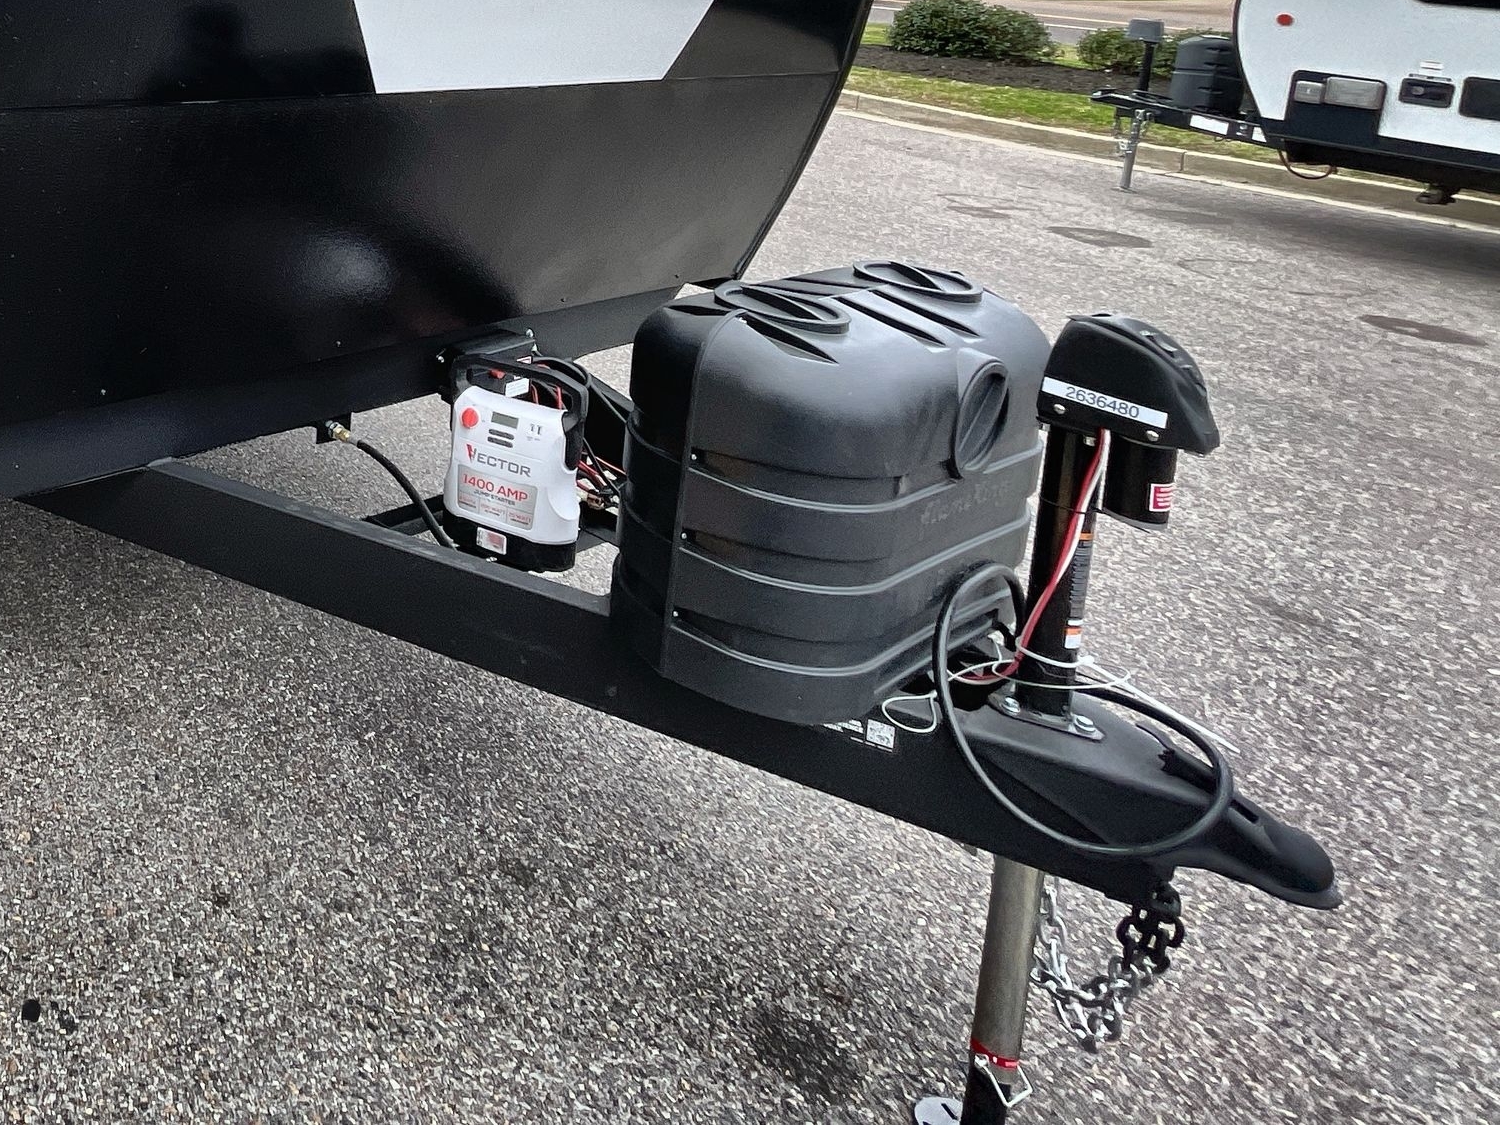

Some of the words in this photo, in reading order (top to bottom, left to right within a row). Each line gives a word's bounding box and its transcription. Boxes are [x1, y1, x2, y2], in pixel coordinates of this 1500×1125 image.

[1065, 386, 1140, 418] 2636480
[466, 443, 531, 478] VECTOR
[463, 473, 495, 492] 1400
[497, 485, 528, 502] AMP
